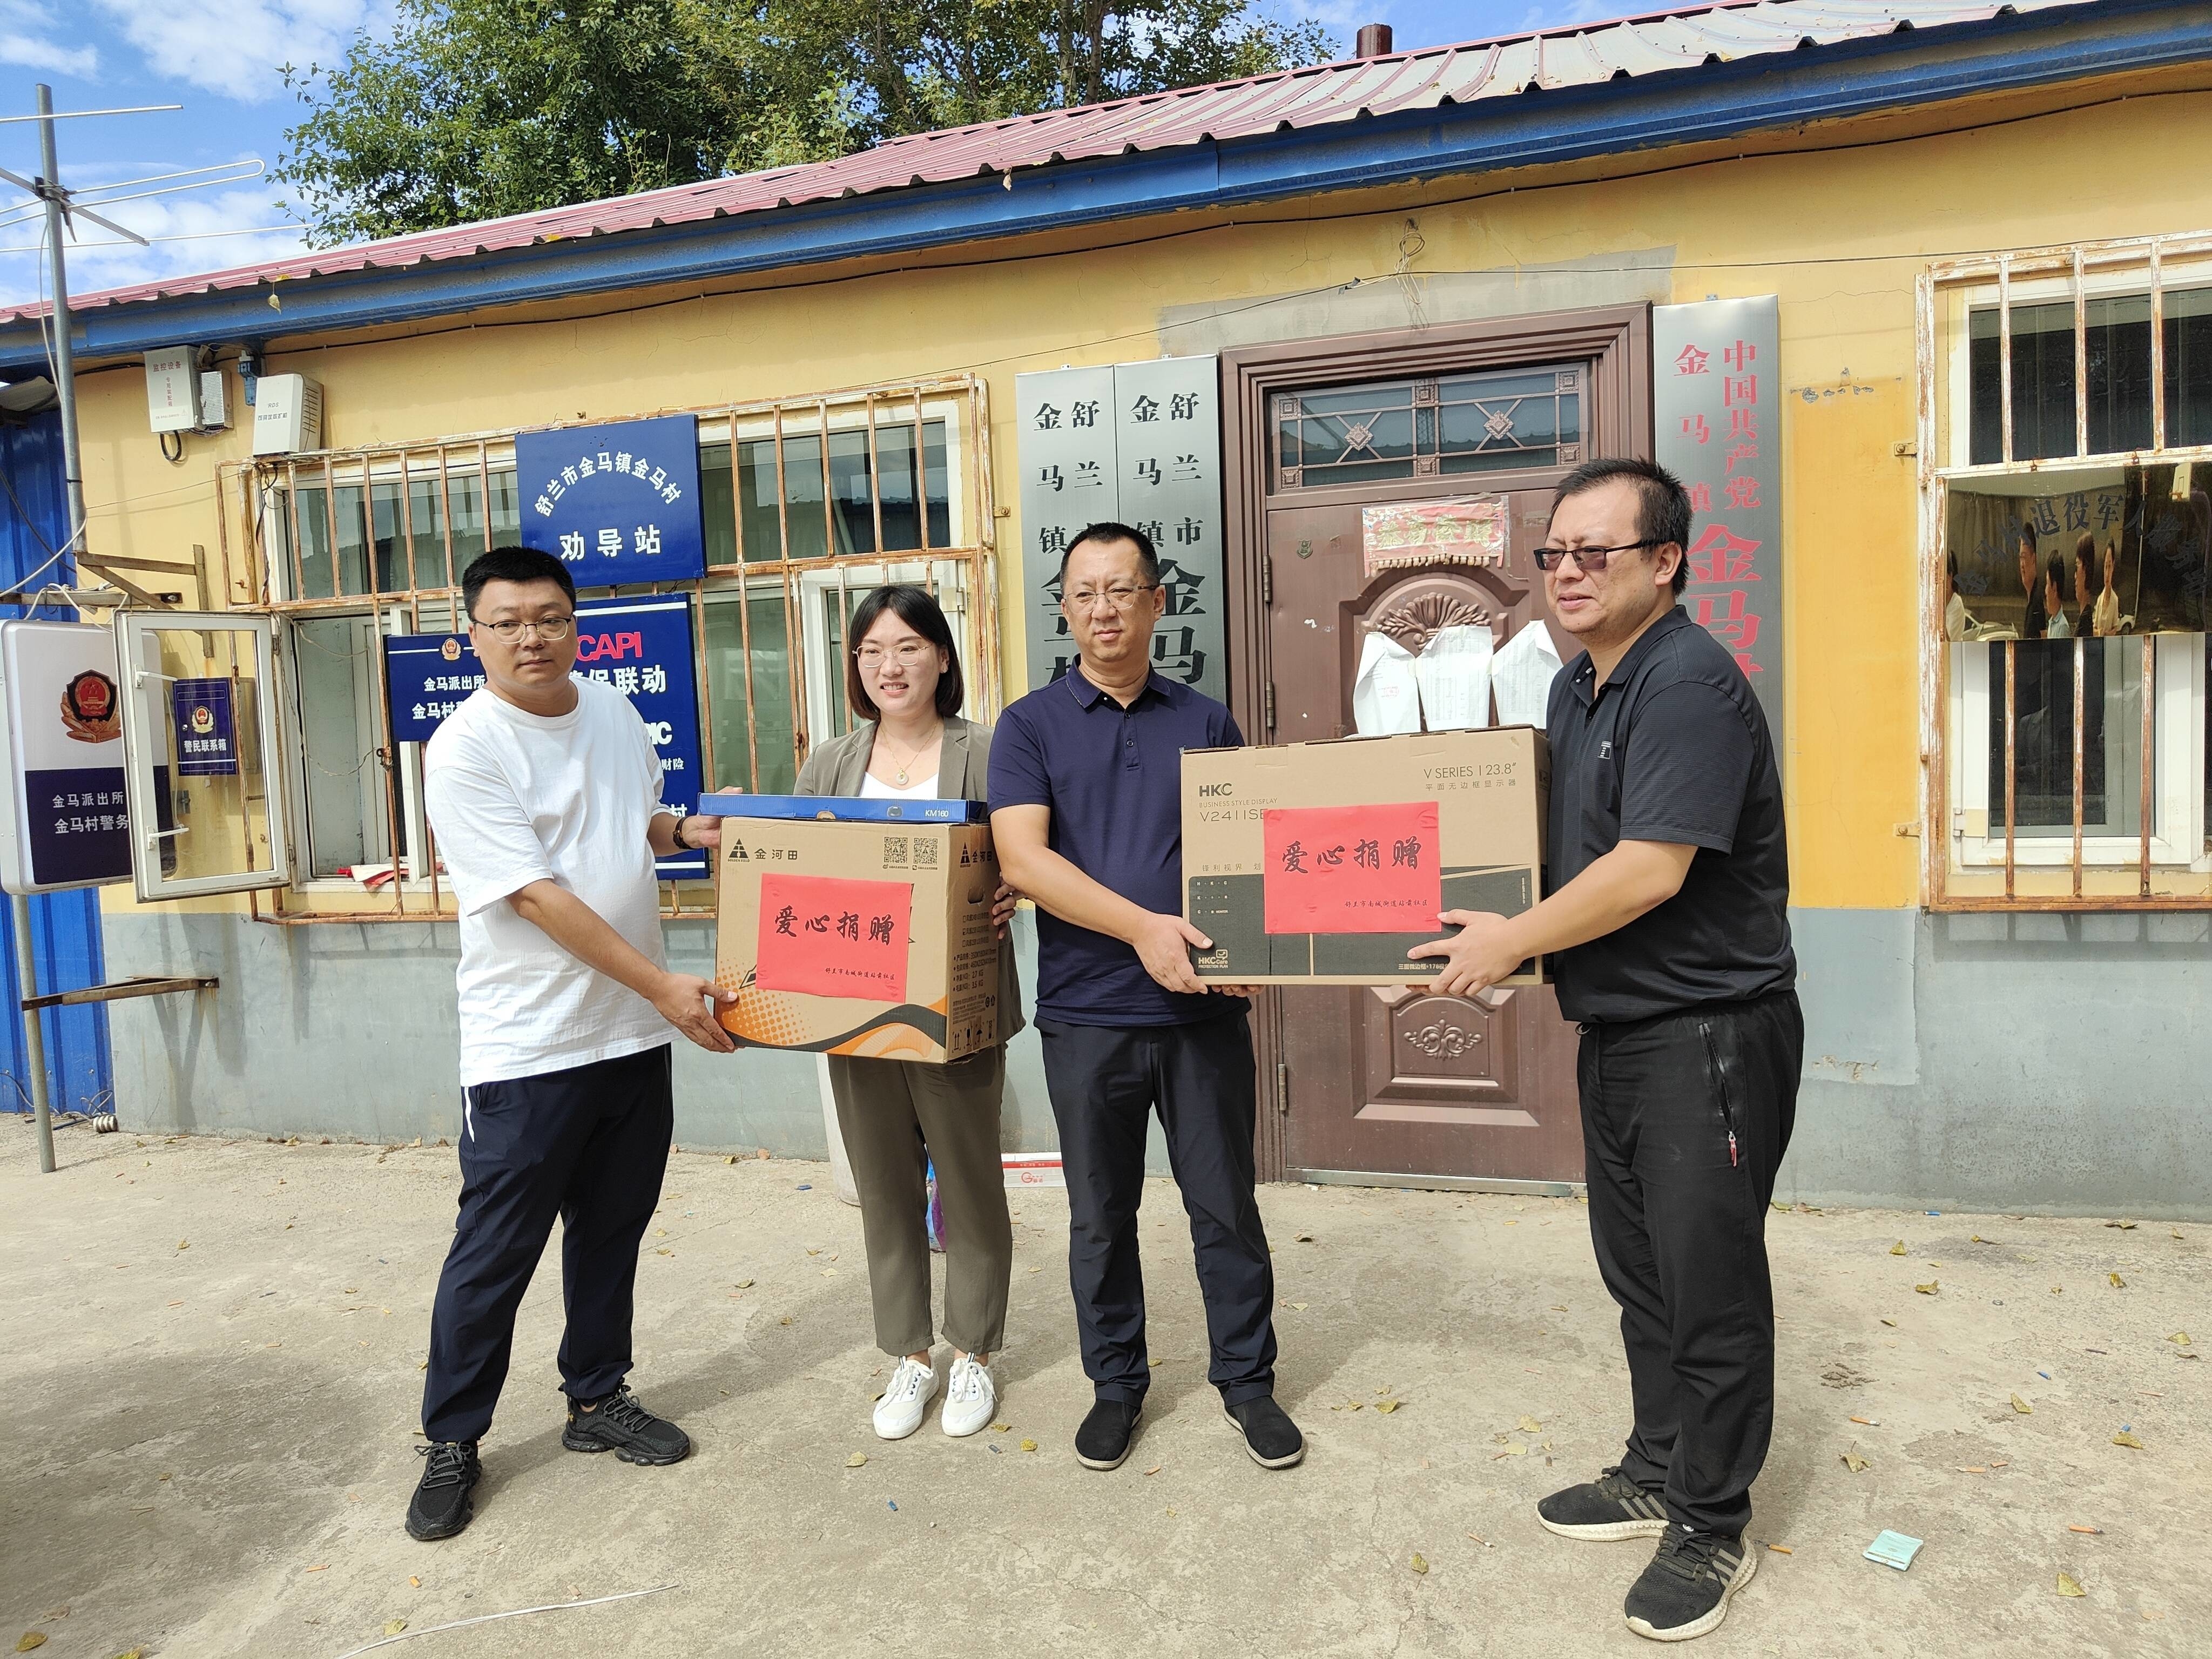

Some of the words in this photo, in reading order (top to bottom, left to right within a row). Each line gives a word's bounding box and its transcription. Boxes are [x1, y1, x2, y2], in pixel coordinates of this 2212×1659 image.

[1723, 340, 1761, 510] 中国共产党
[1071, 400, 1103, 532] 舒兰
[1130, 395, 1165, 548] 金马镇
[1169, 392, 1204, 545] 舒兰市
[534, 451, 682, 517] 舒兰市金马镇金马村
[1033, 403, 1067, 554] 金马镇
[559, 524, 662, 561] 劝导站
[1686, 523, 1764, 679] 金马
[423, 674, 485, 692] 金马派出所
[184, 738, 227, 753] 警民联系箱
[1424, 768, 1432, 779] V
[1435, 766, 1473, 779] SERIES
[1199, 783, 1232, 797] HKC
[1426, 779, 1516, 791] 平面无边框显示器
[52, 791, 124, 808] 金马派出所
[55, 814, 129, 834] 金马村警务
[754, 848, 798, 860] 金河田
[972, 851, 992, 863] 金河田
[1282, 835, 1421, 873] 爱心捐赠
[1203, 864, 1242, 872] 锋利视界
[1345, 899, 1427, 908] 舒兰市南城街道站前社区
[775, 905, 894, 946] 爱心捐赠
[1198, 956, 1216, 965] HKC
